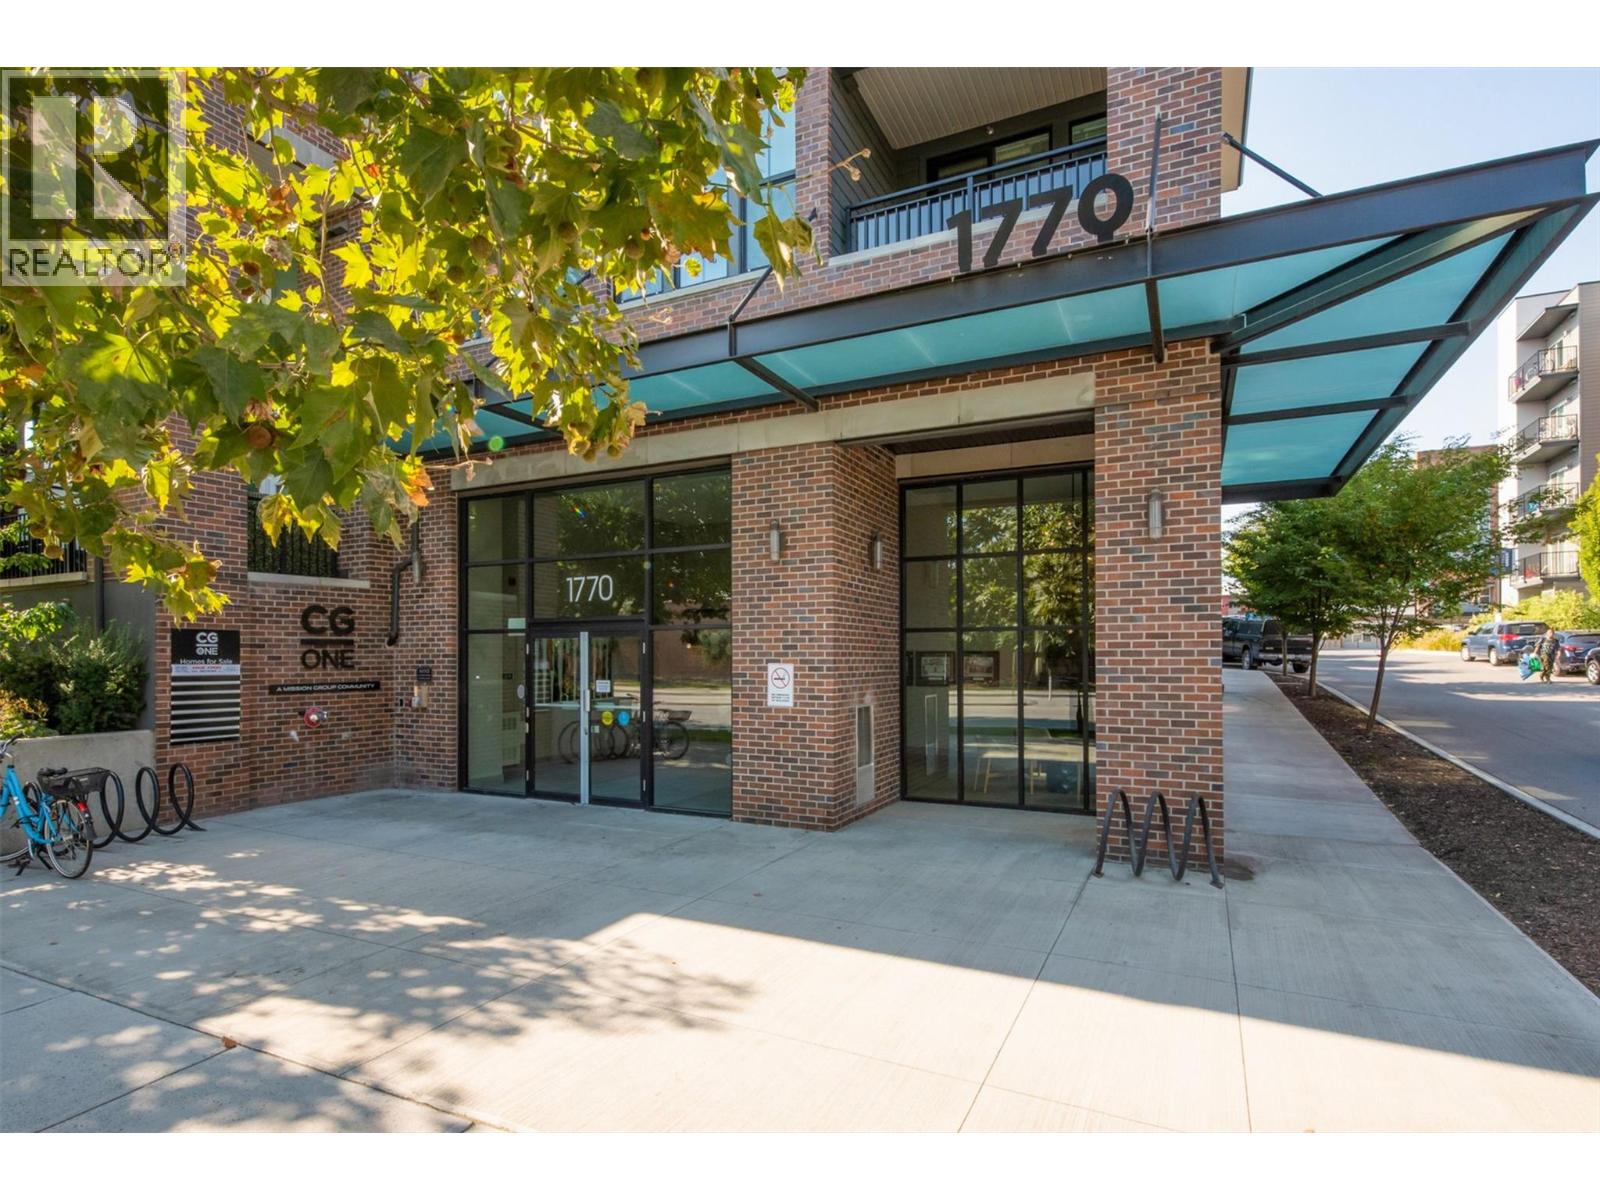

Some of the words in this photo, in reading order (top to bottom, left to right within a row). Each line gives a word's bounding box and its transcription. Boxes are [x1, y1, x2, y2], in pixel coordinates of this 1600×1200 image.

[946, 173, 1134, 271] 1770
[566, 575, 613, 602] 1770
[301, 605, 355, 636] CG
[196, 632, 218, 643] CG
[196, 647, 218, 655] ONE
[301, 649, 355, 669] ONE
